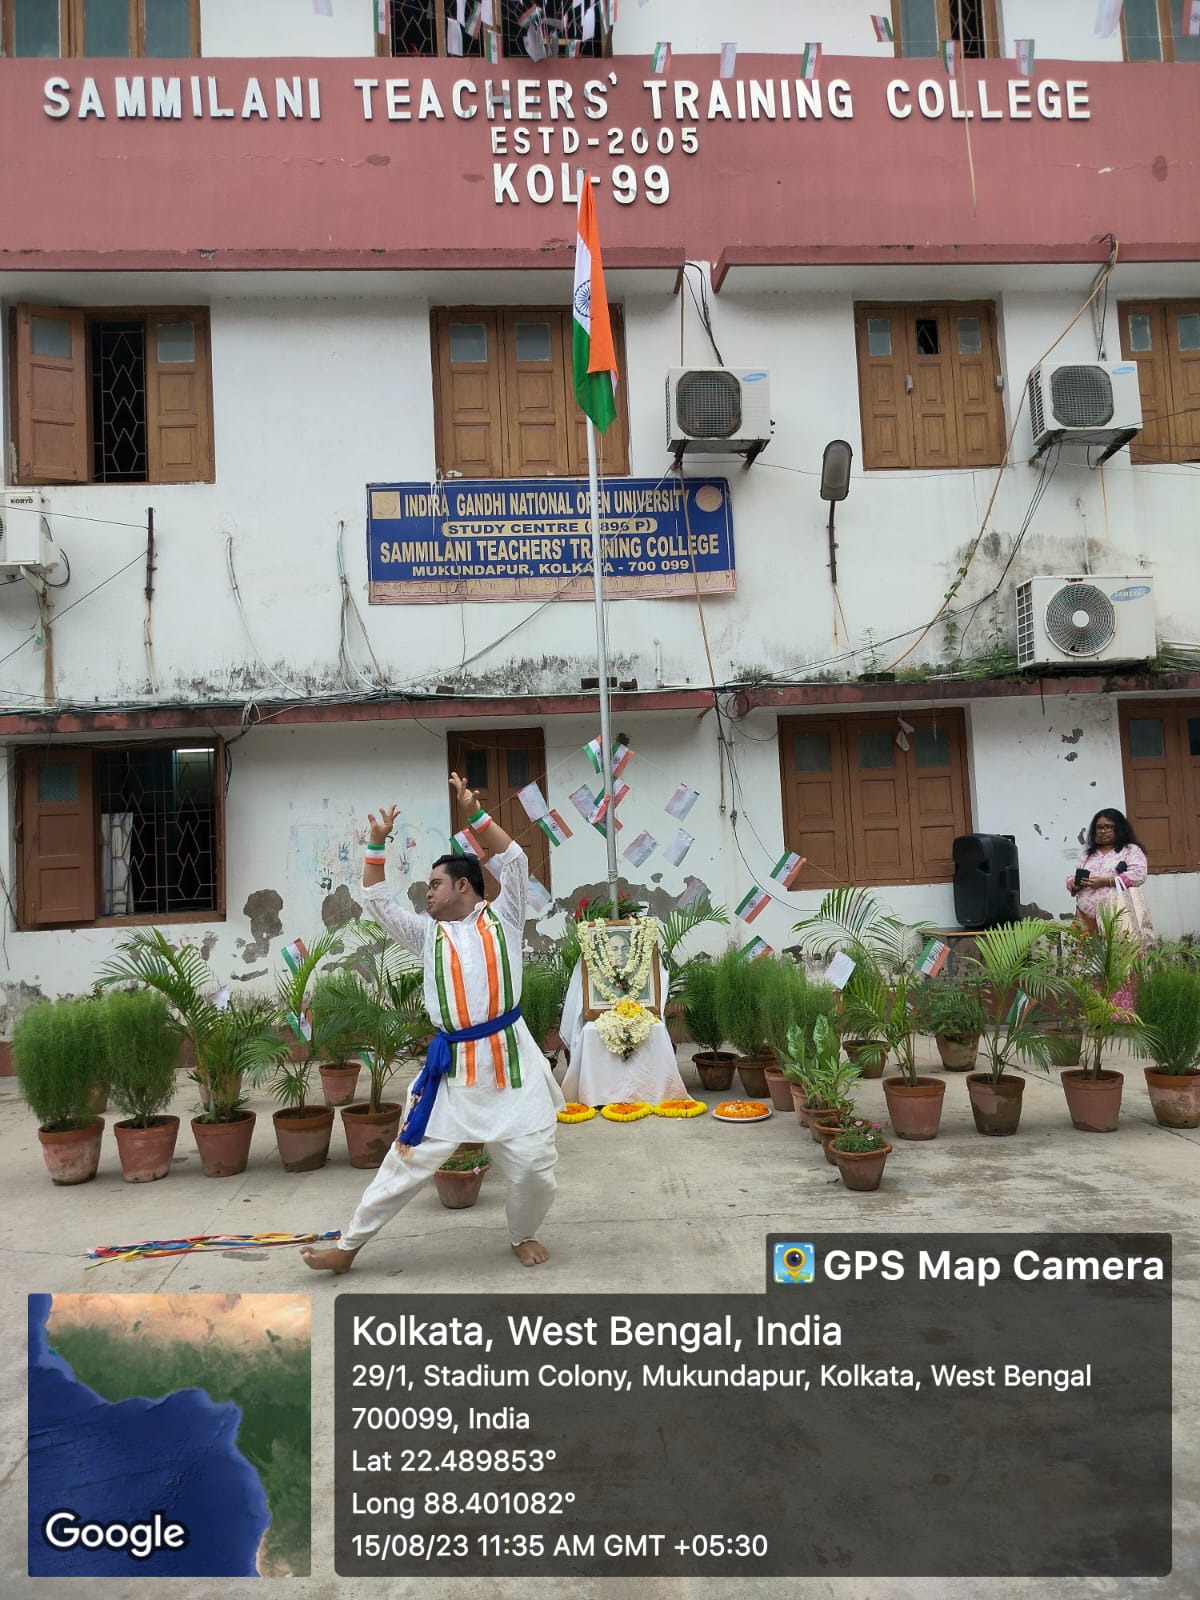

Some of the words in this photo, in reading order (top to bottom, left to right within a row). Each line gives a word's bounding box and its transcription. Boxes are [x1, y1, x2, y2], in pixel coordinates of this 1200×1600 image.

[43, 75, 322, 119] SAMMILANI
[353, 71, 618, 120] TEACHERS'
[643, 78, 854, 120] TRAINING
[886, 78, 1091, 119] COLLEGE
[404, 494, 450, 517] INDIRA
[456, 493, 507, 517] GANDHI
[510, 490, 574, 516] NATIONAL
[448, 523, 505, 535] STUDY
[510, 522, 579, 534] CENTRE
[584, 520, 630, 534] (896
[636, 519, 651, 532] P)
[380, 540, 472, 564] SAMMILANI
[476, 537, 566, 562] TEACHERS'
[569, 535, 642, 560] TRINING
[646, 533, 720, 557] COLLEGE
[412, 563, 535, 577] MUKUNDAPUR,
[539, 562, 615, 575] KOLKAA
[628, 561, 657, 573] 700
[660, 559, 690, 571] 099
